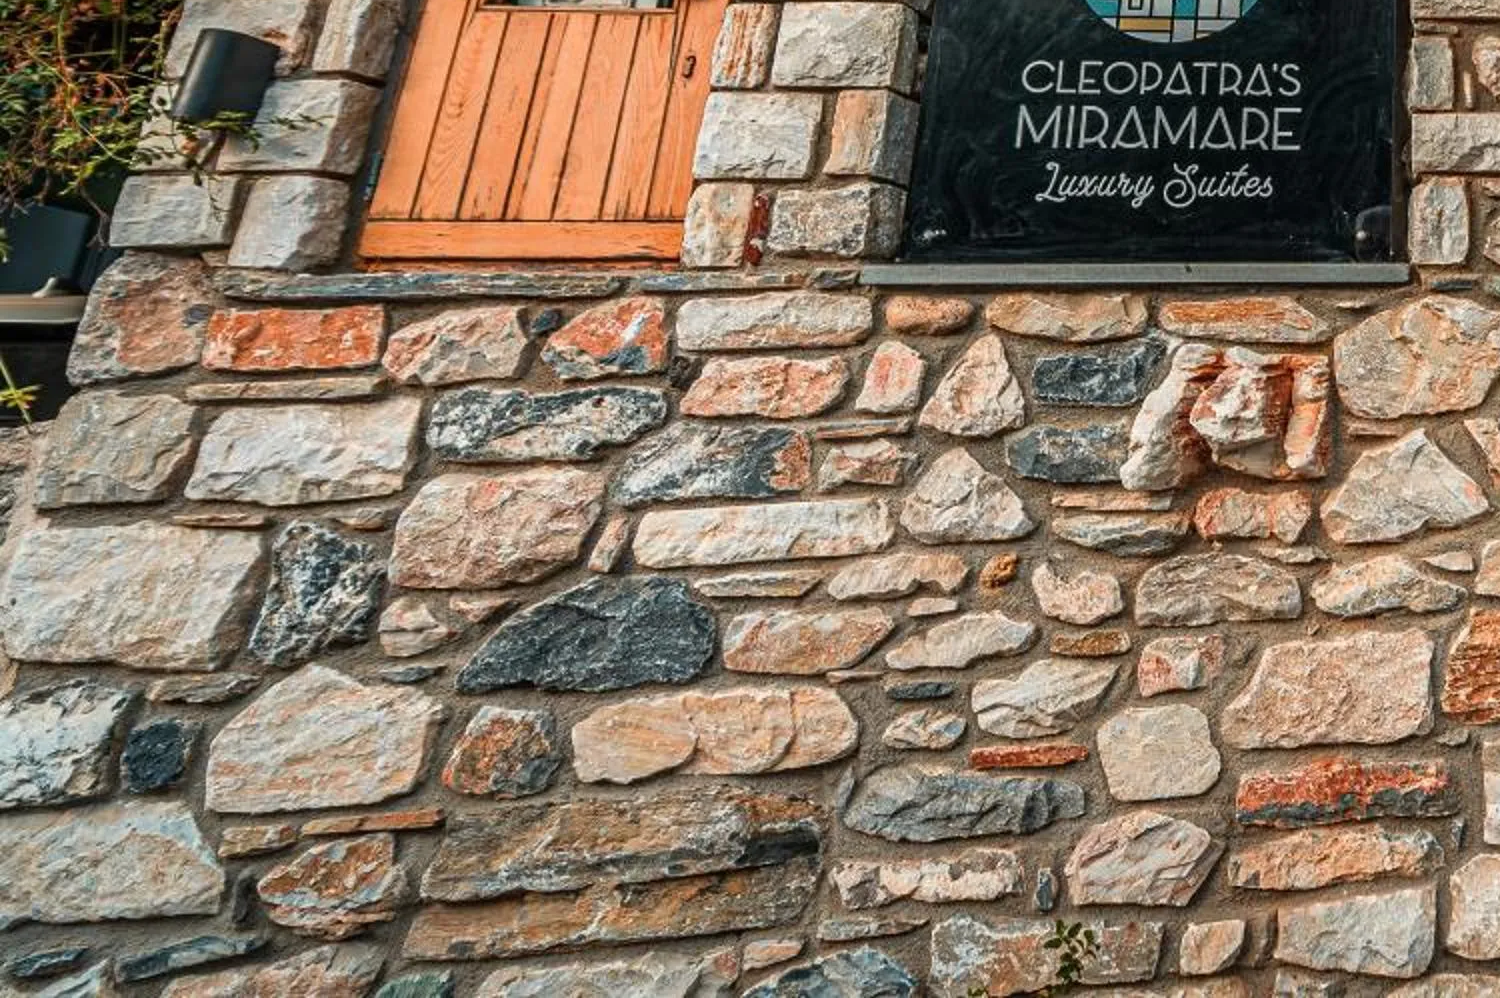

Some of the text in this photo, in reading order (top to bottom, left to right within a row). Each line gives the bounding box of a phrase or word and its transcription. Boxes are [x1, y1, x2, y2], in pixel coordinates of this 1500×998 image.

[1021, 60, 1301, 97] CLEOPATRA'S
[1014, 104, 1302, 151] MIRAMARE
[1035, 161, 1274, 208] Luxury Suites
